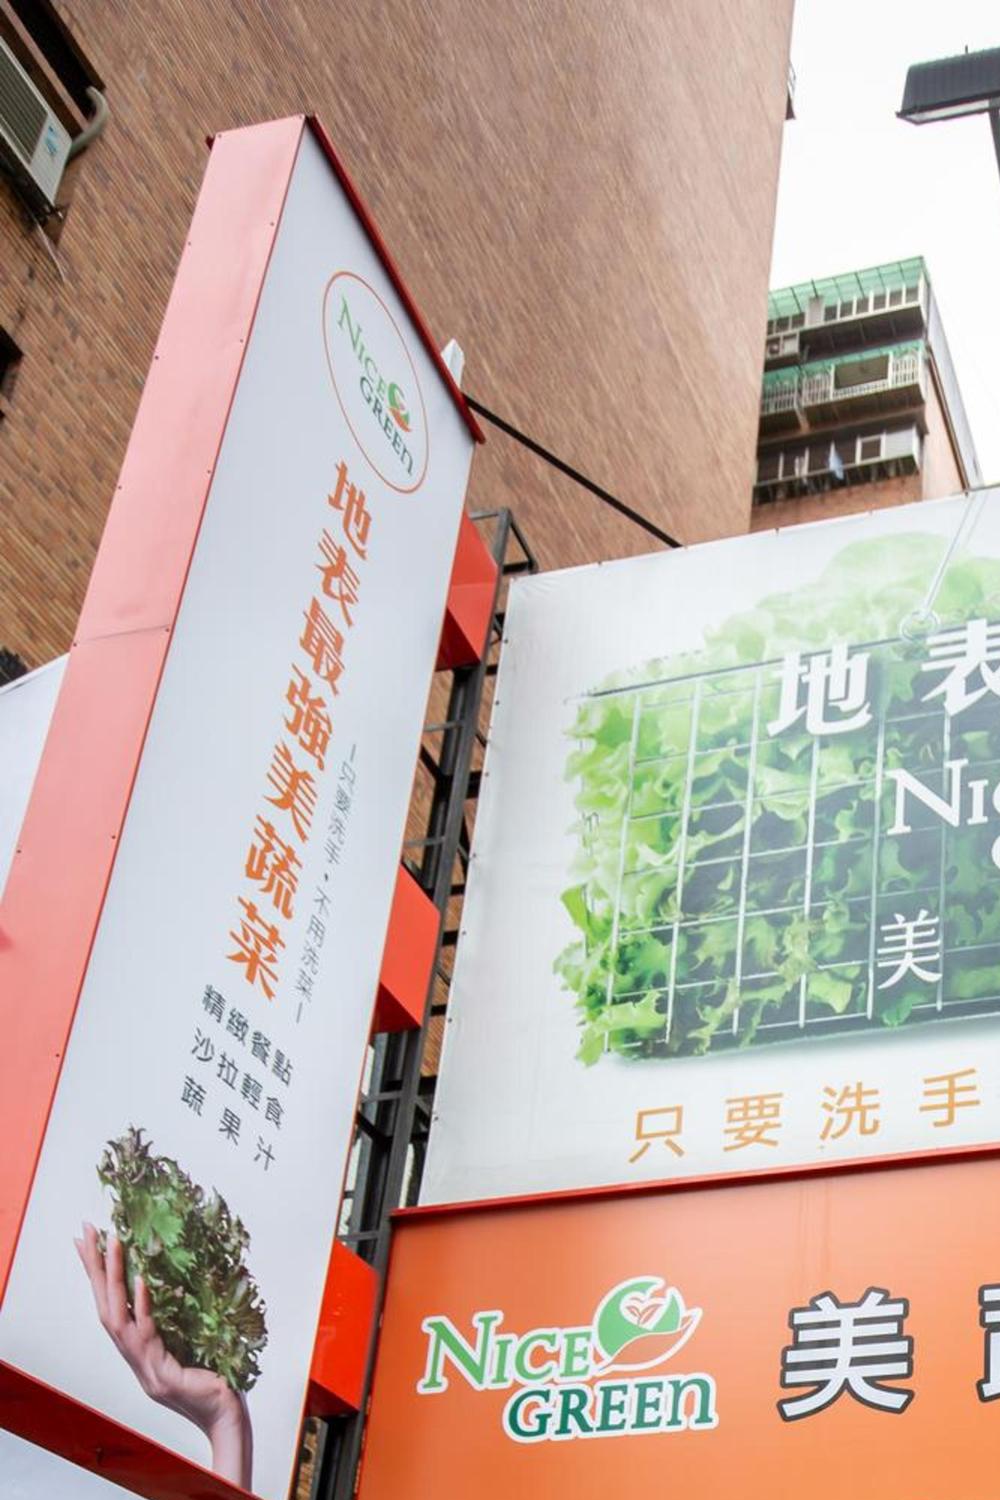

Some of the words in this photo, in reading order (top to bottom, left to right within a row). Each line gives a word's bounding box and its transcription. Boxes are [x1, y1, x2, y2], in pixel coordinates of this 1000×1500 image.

[337, 297, 392, 399] NICE
[225, 460, 373, 1001] 地表最強美蔬菜
[191, 1027, 285, 1132] 沙拉輕食
[201, 984, 294, 1087] 精緻餐點
[181, 1075, 276, 1170] 蔬果汁
[417, 1311, 594, 1394] NICE
